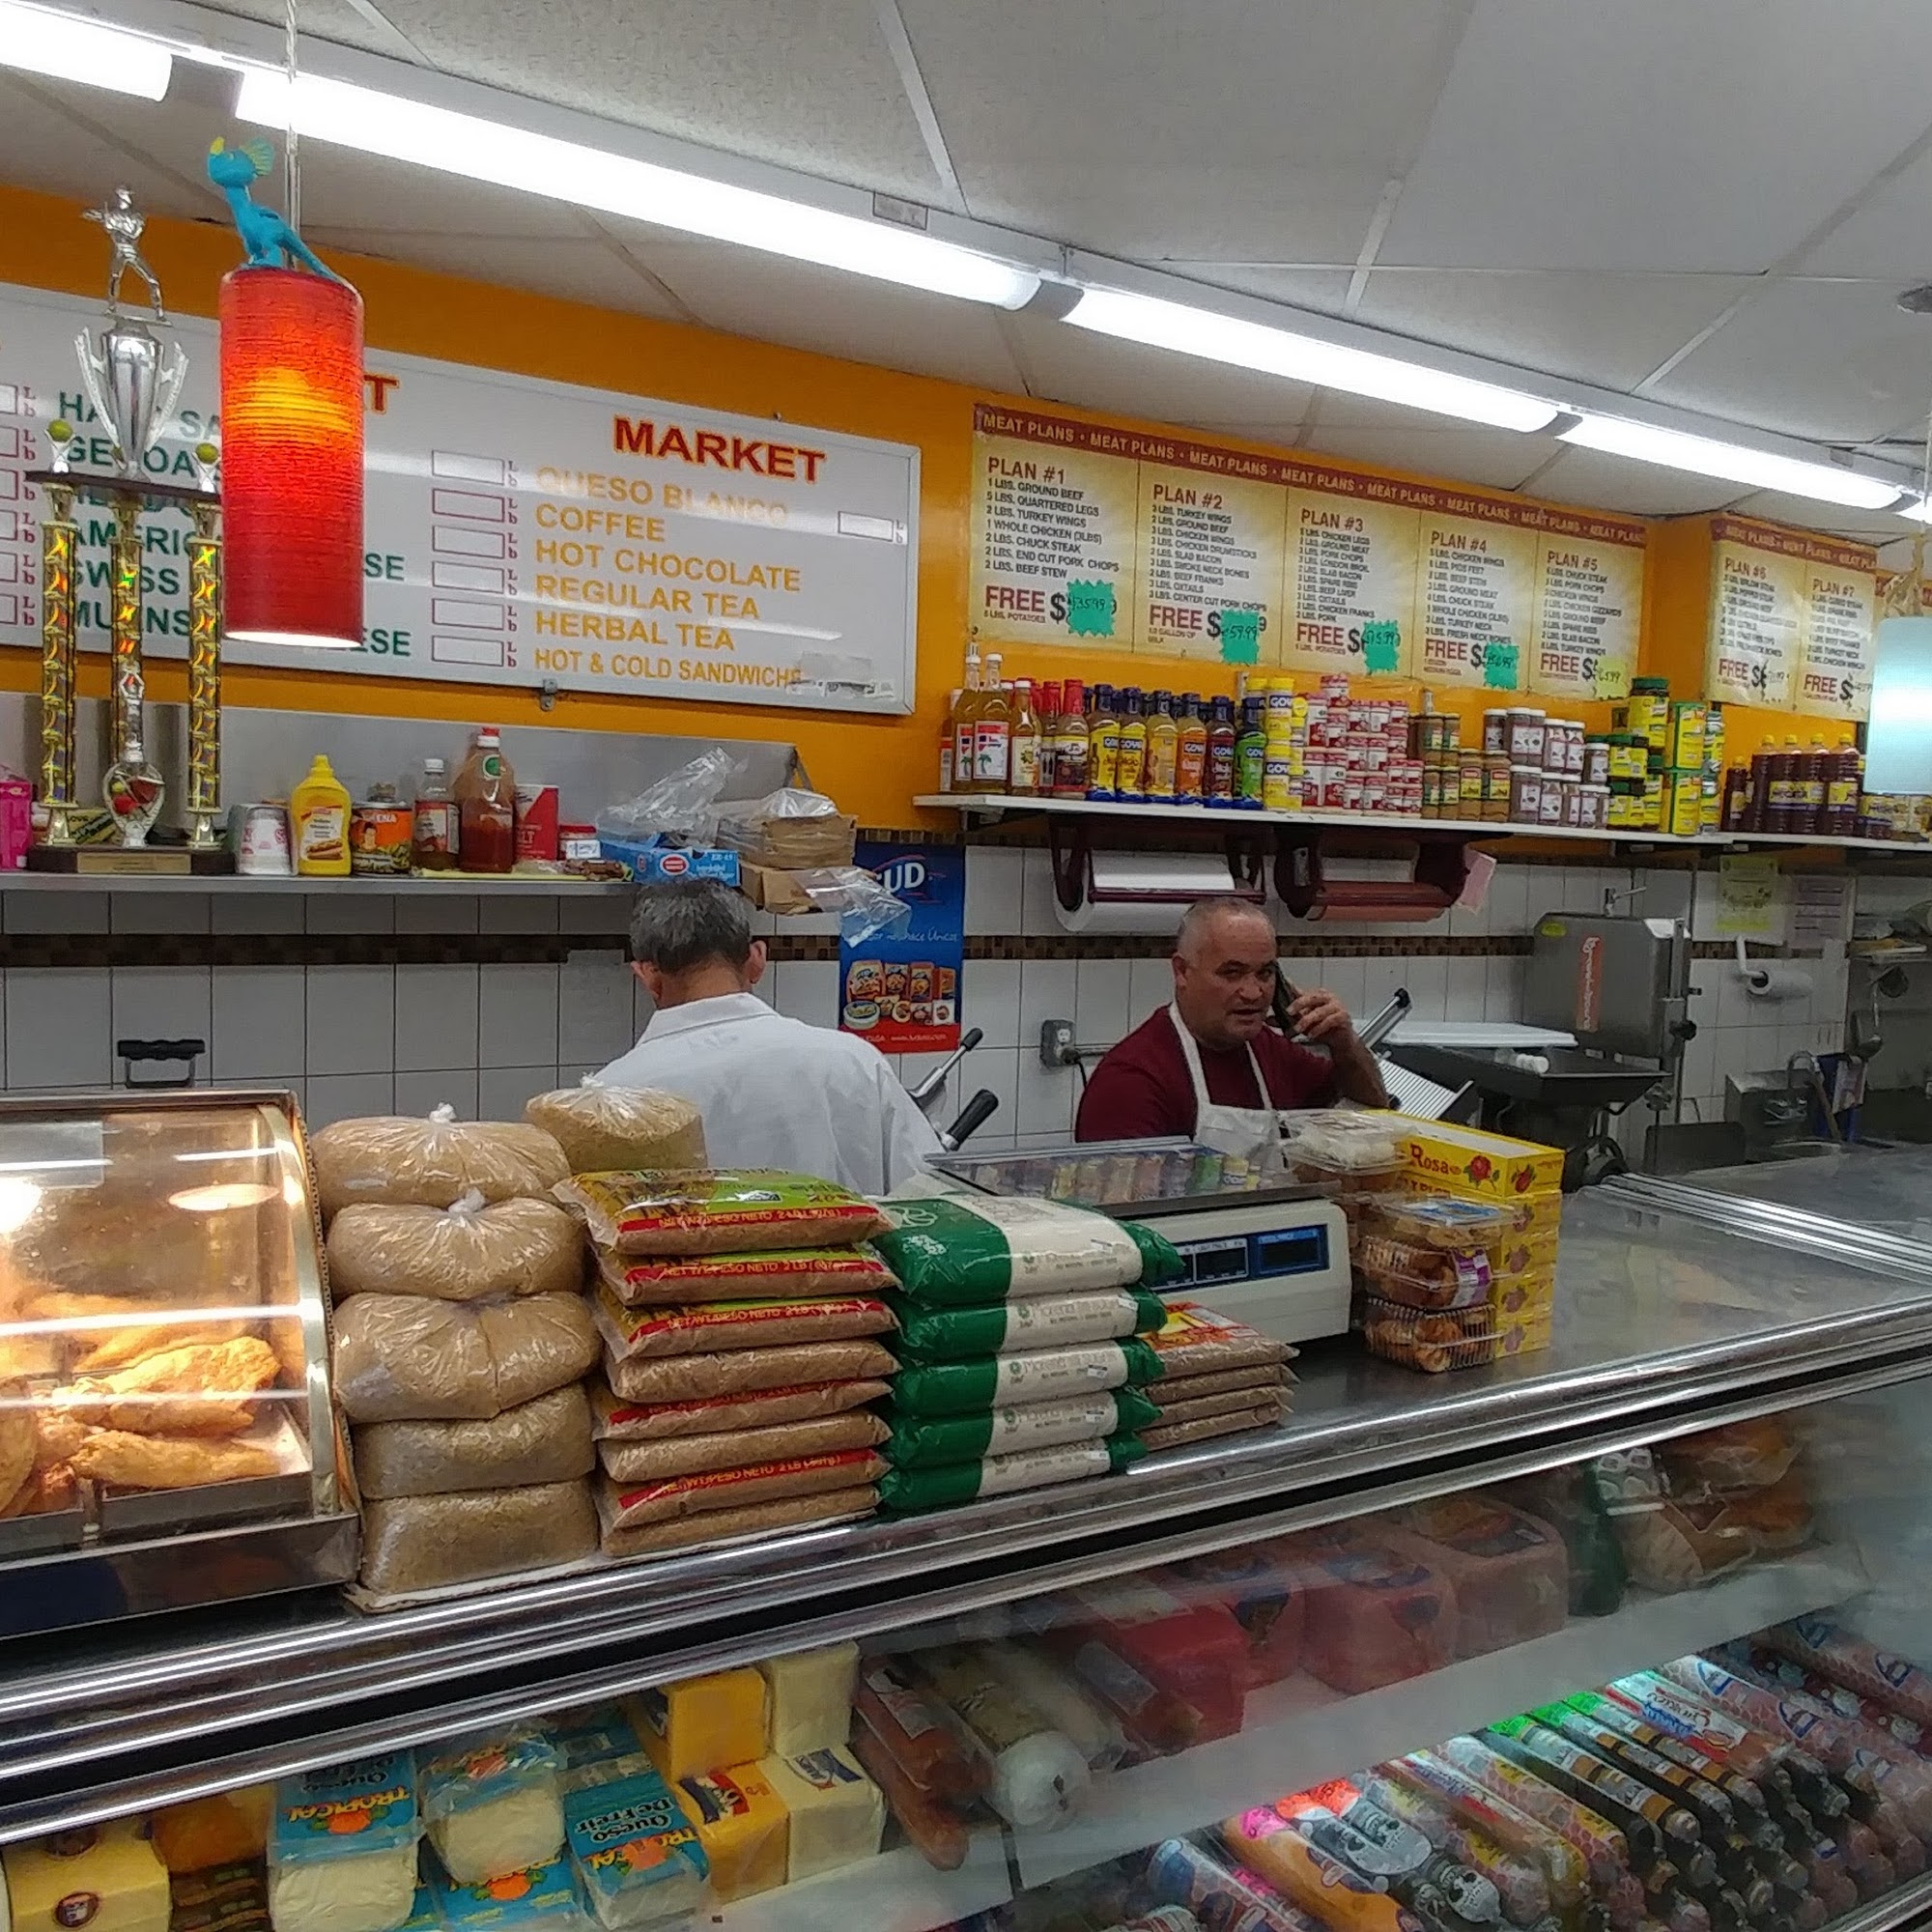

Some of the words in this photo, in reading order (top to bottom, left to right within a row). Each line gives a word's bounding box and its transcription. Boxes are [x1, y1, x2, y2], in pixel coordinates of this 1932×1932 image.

[613, 416, 826, 483] MARKET
[983, 412, 1023, 433] MEAT
[1027, 421, 1073, 441] PLANS
[1090, 432, 1127, 451] MEAT
[1131, 440, 1174, 460] PLANS
[1189, 450, 1224, 468] MEAT
[1227, 458, 1267, 476] PLANS
[1281, 467, 1314, 483] MEAT
[1317, 473, 1355, 492] PLANS
[1367, 482, 1397, 498] MEAT
[1400, 489, 1435, 505] PLANS
[1446, 497, 1475, 513] MEAT
[1478, 503, 1510, 519] PLANS
[987, 456, 1037, 480] PLAN
[1042, 465, 1064, 484] #1
[536, 467, 654, 505] QUESO
[1017, 482, 1058, 497] GROUND
[1060, 489, 1083, 500] BEEF
[1152, 484, 1196, 505] PLAN
[1201, 492, 1222, 510] #2
[1017, 496, 1073, 513] QUARTERED
[1075, 504, 1098, 517] LEGS
[1017, 509, 1054, 523] TURKEY
[1056, 515, 1086, 527] WINGS
[534, 500, 665, 543] COFFEE
[993, 520, 1027, 533] WHOLE
[1030, 525, 1071, 539] CHICKEN
[1301, 508, 1340, 528] PLAN
[1344, 515, 1363, 532] #3
[1016, 536, 1049, 550] CHUCK
[1051, 541, 1081, 554] STEAK
[1431, 530, 1466, 549] PLAN
[1469, 537, 1487, 553] #4
[534, 537, 604, 570] HOT
[614, 546, 801, 592] CHOCOLATE
[1015, 550, 1036, 561] END
[1037, 553, 1056, 563] CUT
[1088, 559, 1119, 572] CHOPS
[1015, 563, 1038, 575] BEEF
[1040, 566, 1067, 579] STEW
[1547, 550, 1578, 568] PLAN
[1582, 556, 1597, 571] #5
[1724, 556, 1749, 576] PLAN
[534, 573, 693, 613] REGULAR
[703, 592, 760, 620] TEA
[984, 584, 1045, 612] FREE
[1812, 578, 1839, 595] PLAN
[1149, 604, 1203, 630] FREE
[534, 610, 668, 645] HERBAL
[676, 623, 733, 651] TEA
[1296, 622, 1344, 646] FREE
[1424, 638, 1467, 661] FREE
[534, 647, 583, 672] HOT
[590, 652, 604, 673] &
[611, 653, 670, 679] COLD
[1540, 652, 1579, 674] FREE
[1719, 658, 1748, 680] FREE
[1804, 672, 1837, 695] FREE
[1409, 1143, 1450, 1176] Rosa
[287, 1785, 410, 1824] TROPICAL
[591, 1815, 670, 1842] Queso
